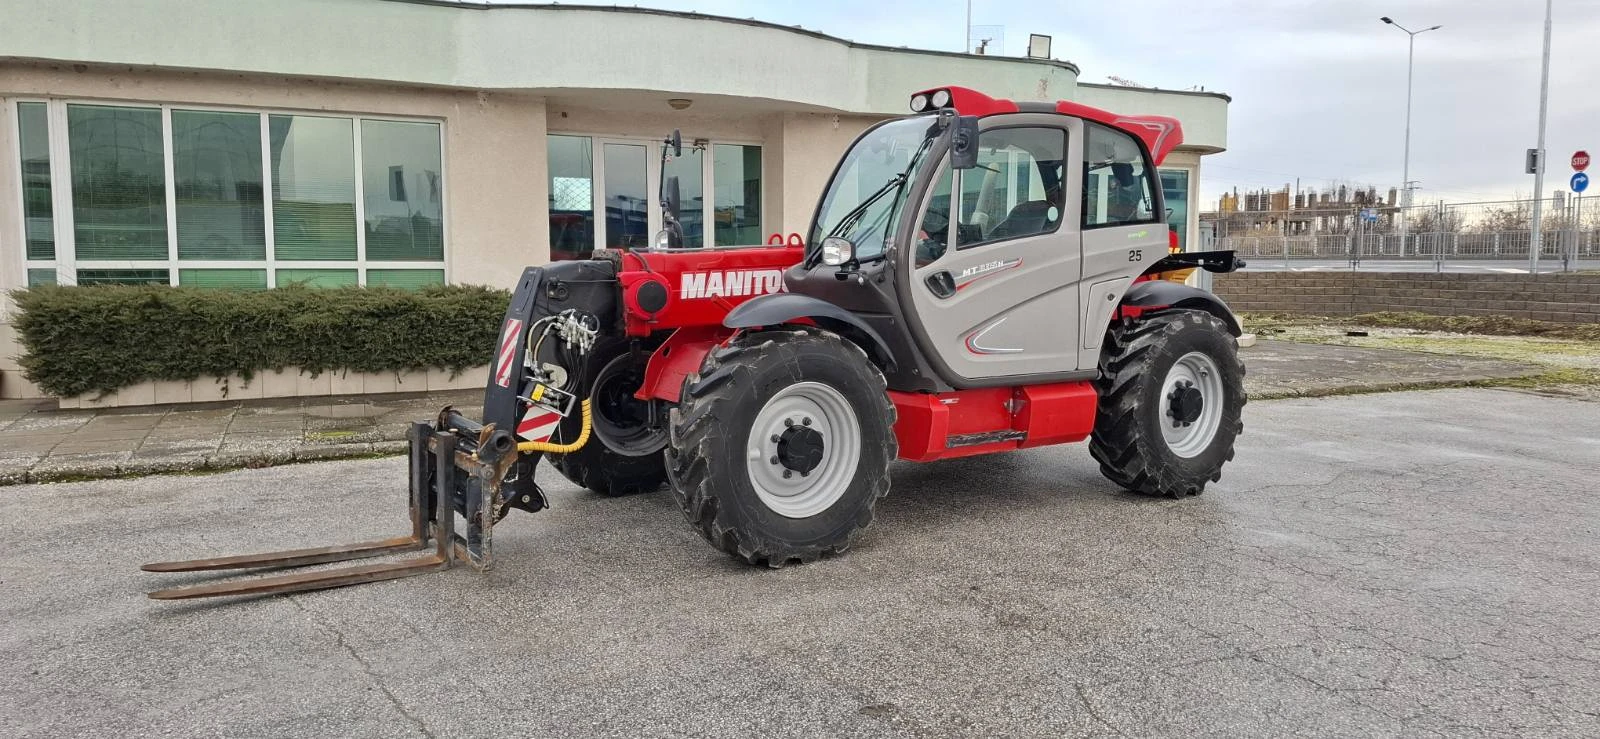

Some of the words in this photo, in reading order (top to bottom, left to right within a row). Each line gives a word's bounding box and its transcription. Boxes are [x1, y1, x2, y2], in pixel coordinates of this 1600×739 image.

[1572, 157, 1588, 166] STOP
[1128, 250, 1142, 262] 25
[963, 266, 978, 277] MT
